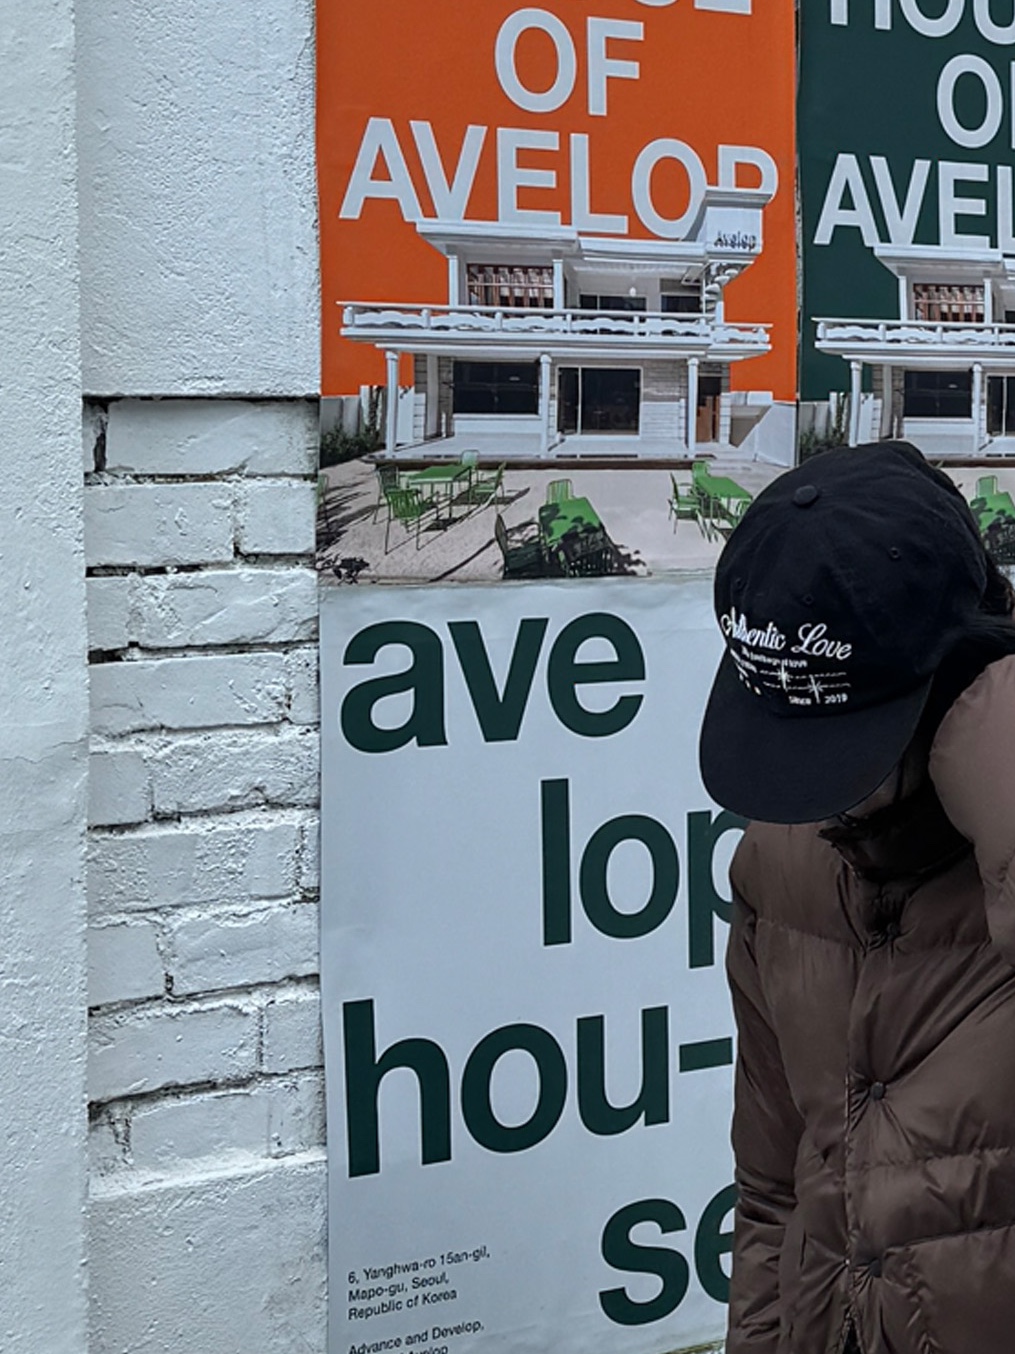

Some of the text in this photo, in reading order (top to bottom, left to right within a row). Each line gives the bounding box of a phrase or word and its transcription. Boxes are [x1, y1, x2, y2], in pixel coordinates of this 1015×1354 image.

[495, 7, 645, 116] OF
[790, 622, 853, 661] Love
[340, 611, 647, 754] ave
[342, 998, 734, 1179] hou-
[347, 1245, 491, 1285] 6, Yanghwa-ro 15an-gil,
[347, 1271, 450, 1303] Mapo-gu, Seoul,
[347, 1289, 458, 1321] Republic of Korea
[405, 1330, 429, 1346] and
[431, 1320, 485, 1340] Develop,
